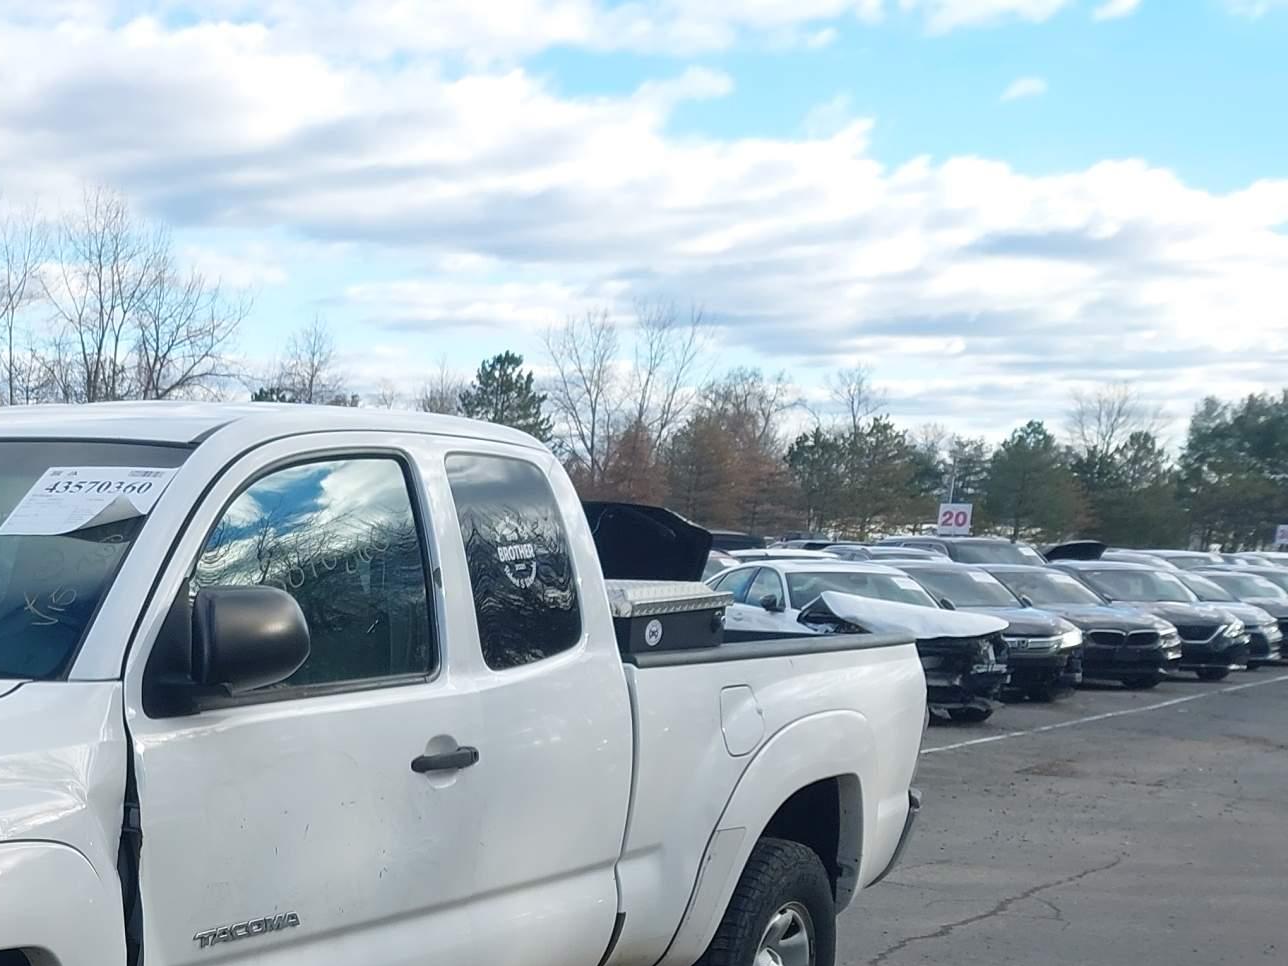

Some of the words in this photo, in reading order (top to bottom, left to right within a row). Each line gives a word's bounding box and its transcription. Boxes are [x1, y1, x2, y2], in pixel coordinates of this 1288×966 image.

[45, 480, 153, 495] 43570360
[941, 510, 968, 527] 20
[497, 543, 535, 562] BROTHER
[193, 911, 301, 948] TACOMA
